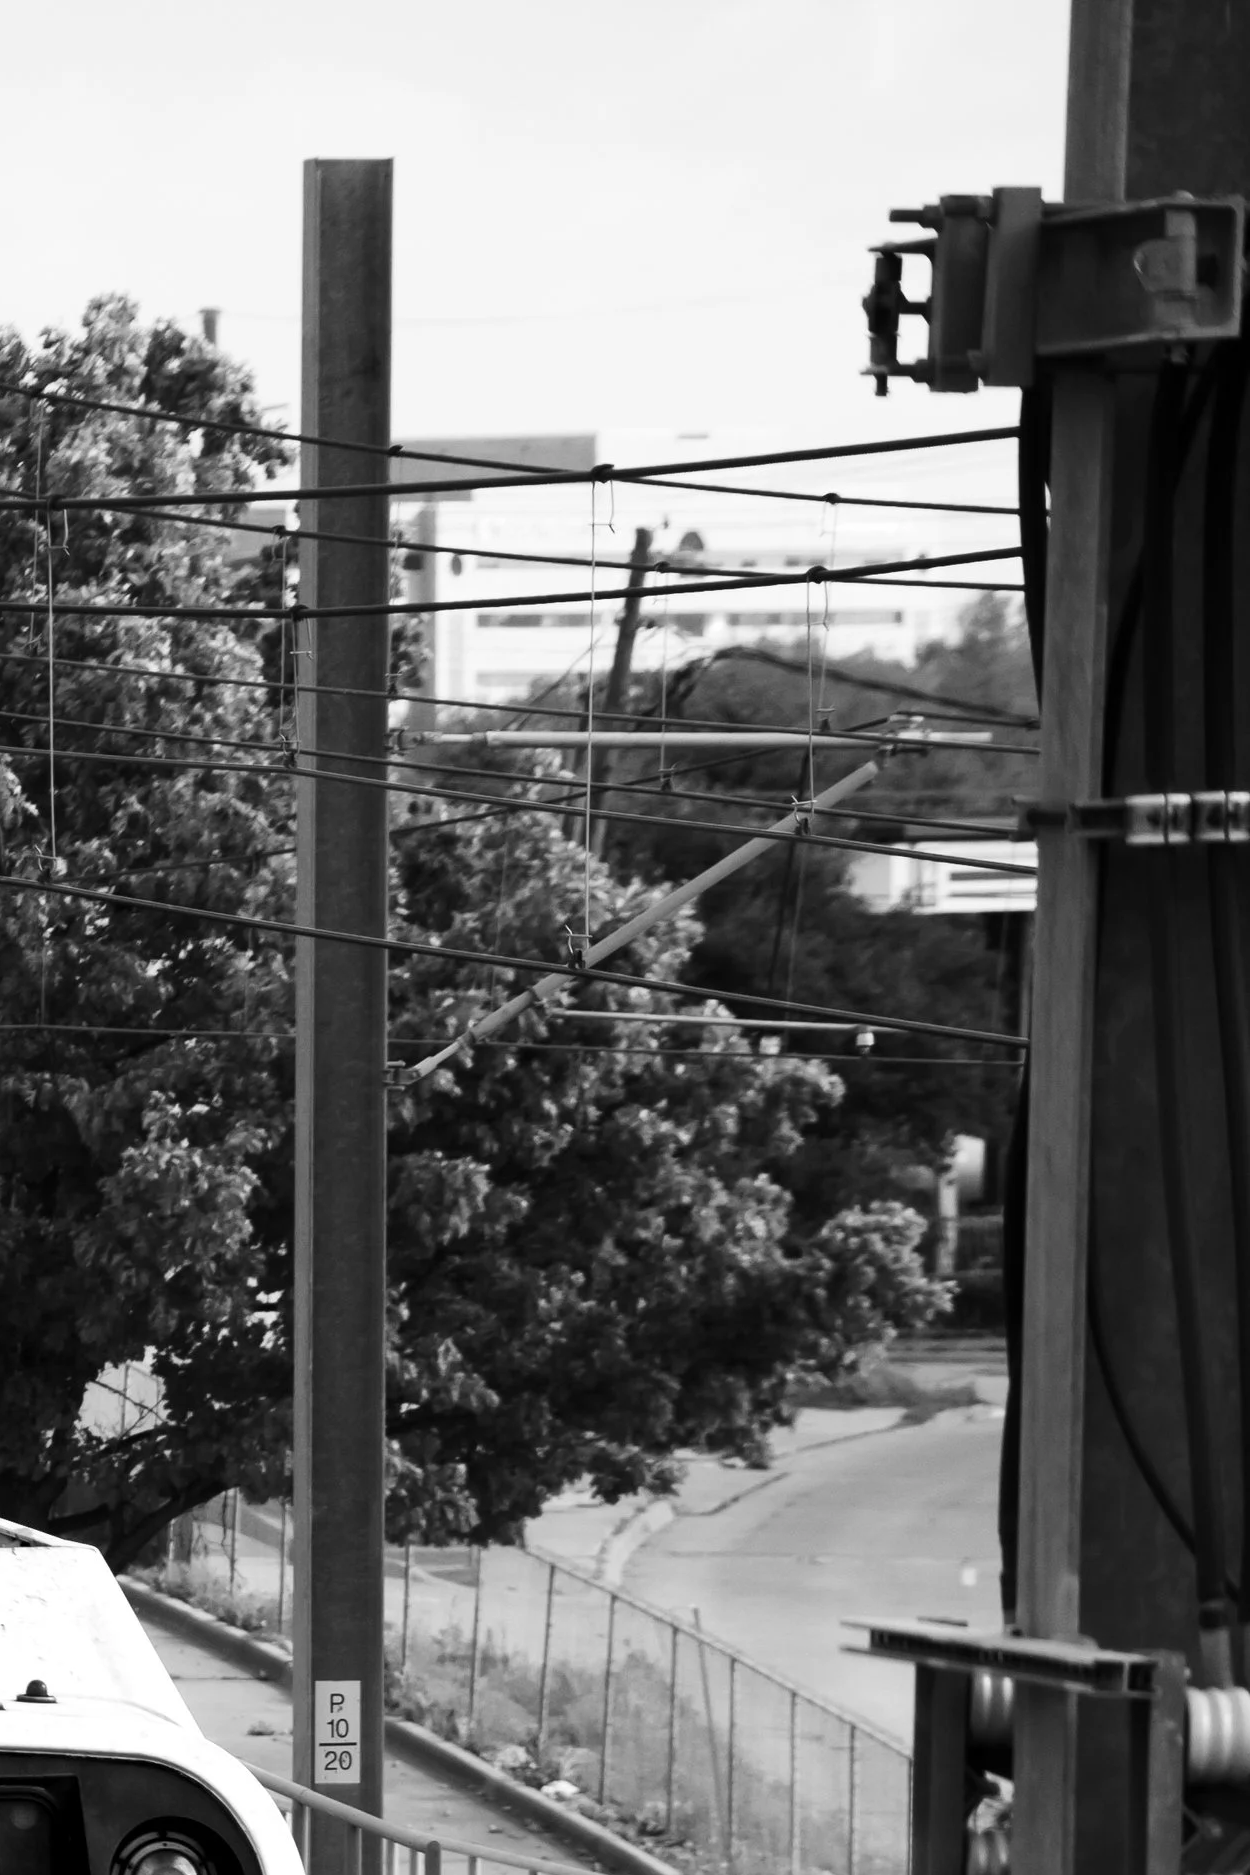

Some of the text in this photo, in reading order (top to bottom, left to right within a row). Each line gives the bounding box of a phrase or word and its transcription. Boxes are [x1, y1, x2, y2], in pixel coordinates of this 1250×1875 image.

[329, 1693, 345, 1713] P
[326, 1718, 349, 1738] 10
[324, 1750, 352, 1771] 20
